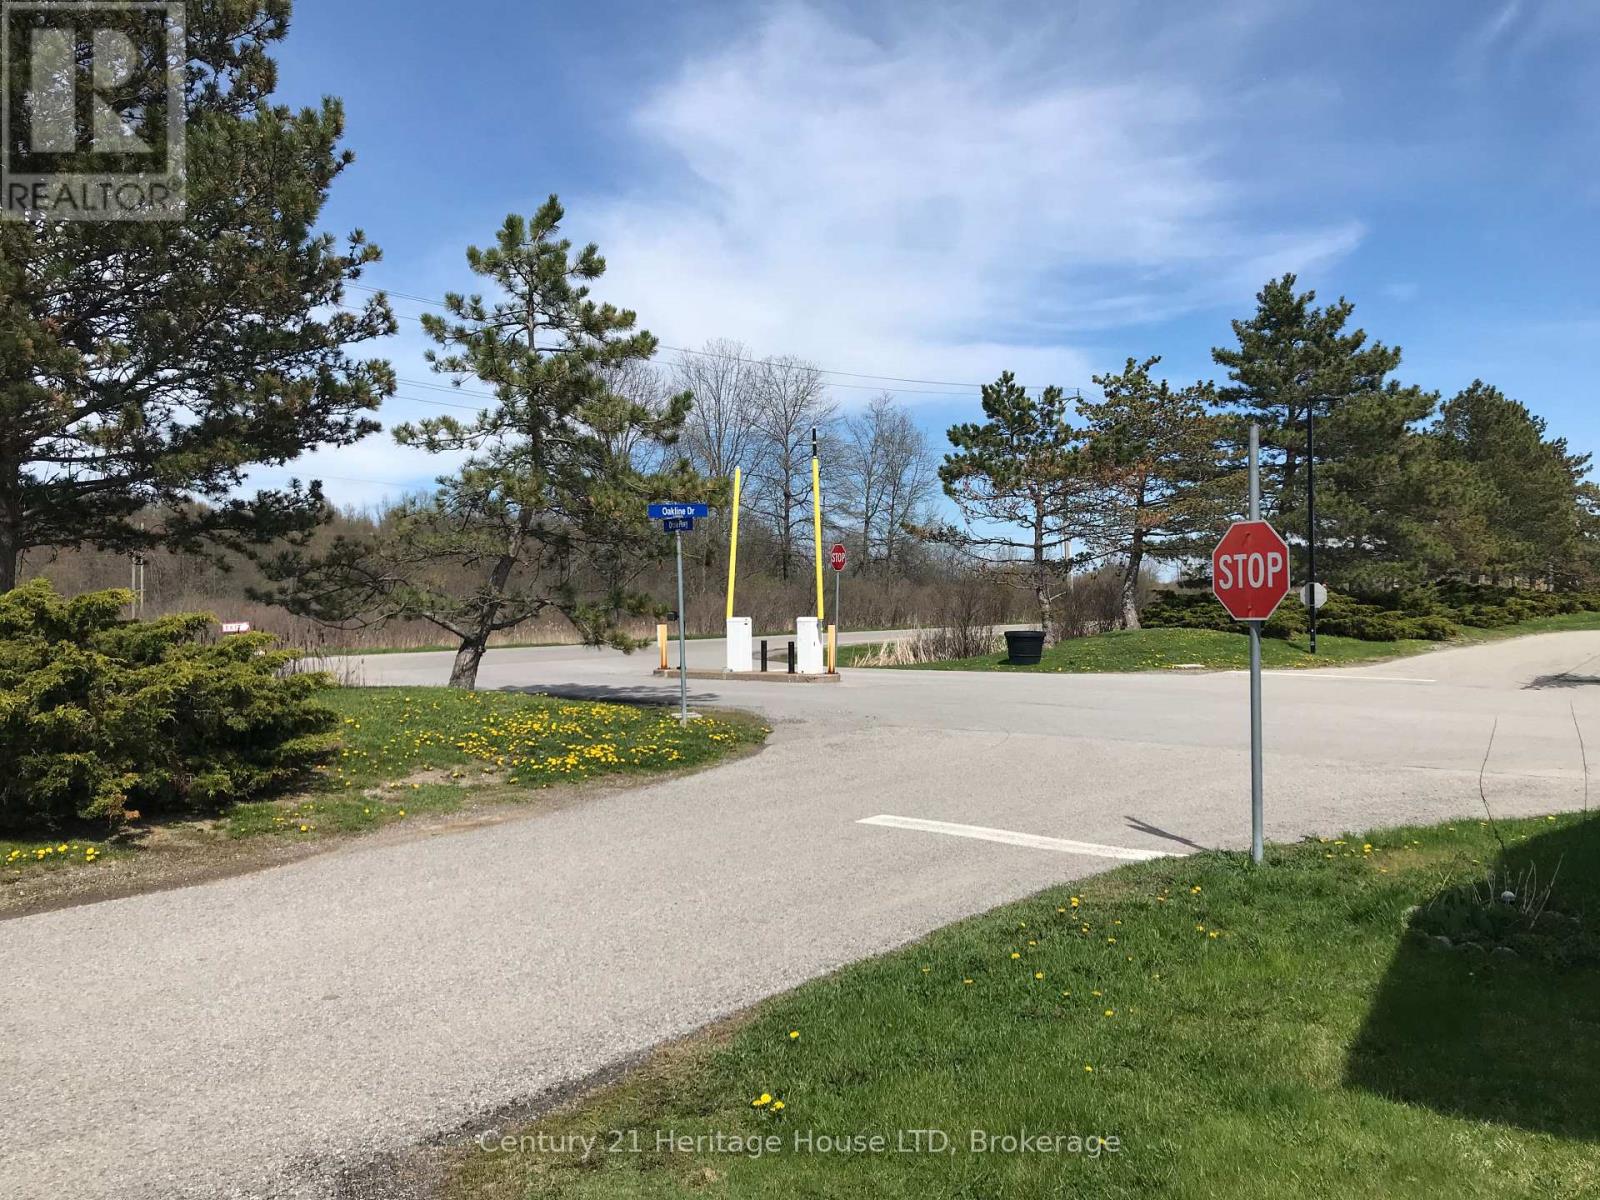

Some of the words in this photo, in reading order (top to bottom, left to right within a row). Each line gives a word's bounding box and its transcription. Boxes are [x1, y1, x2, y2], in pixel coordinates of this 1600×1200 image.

[662, 506, 686, 516] Oakline
[687, 506, 695, 515] Dr
[832, 552, 846, 562] STOP
[1219, 552, 1283, 589] STOP
